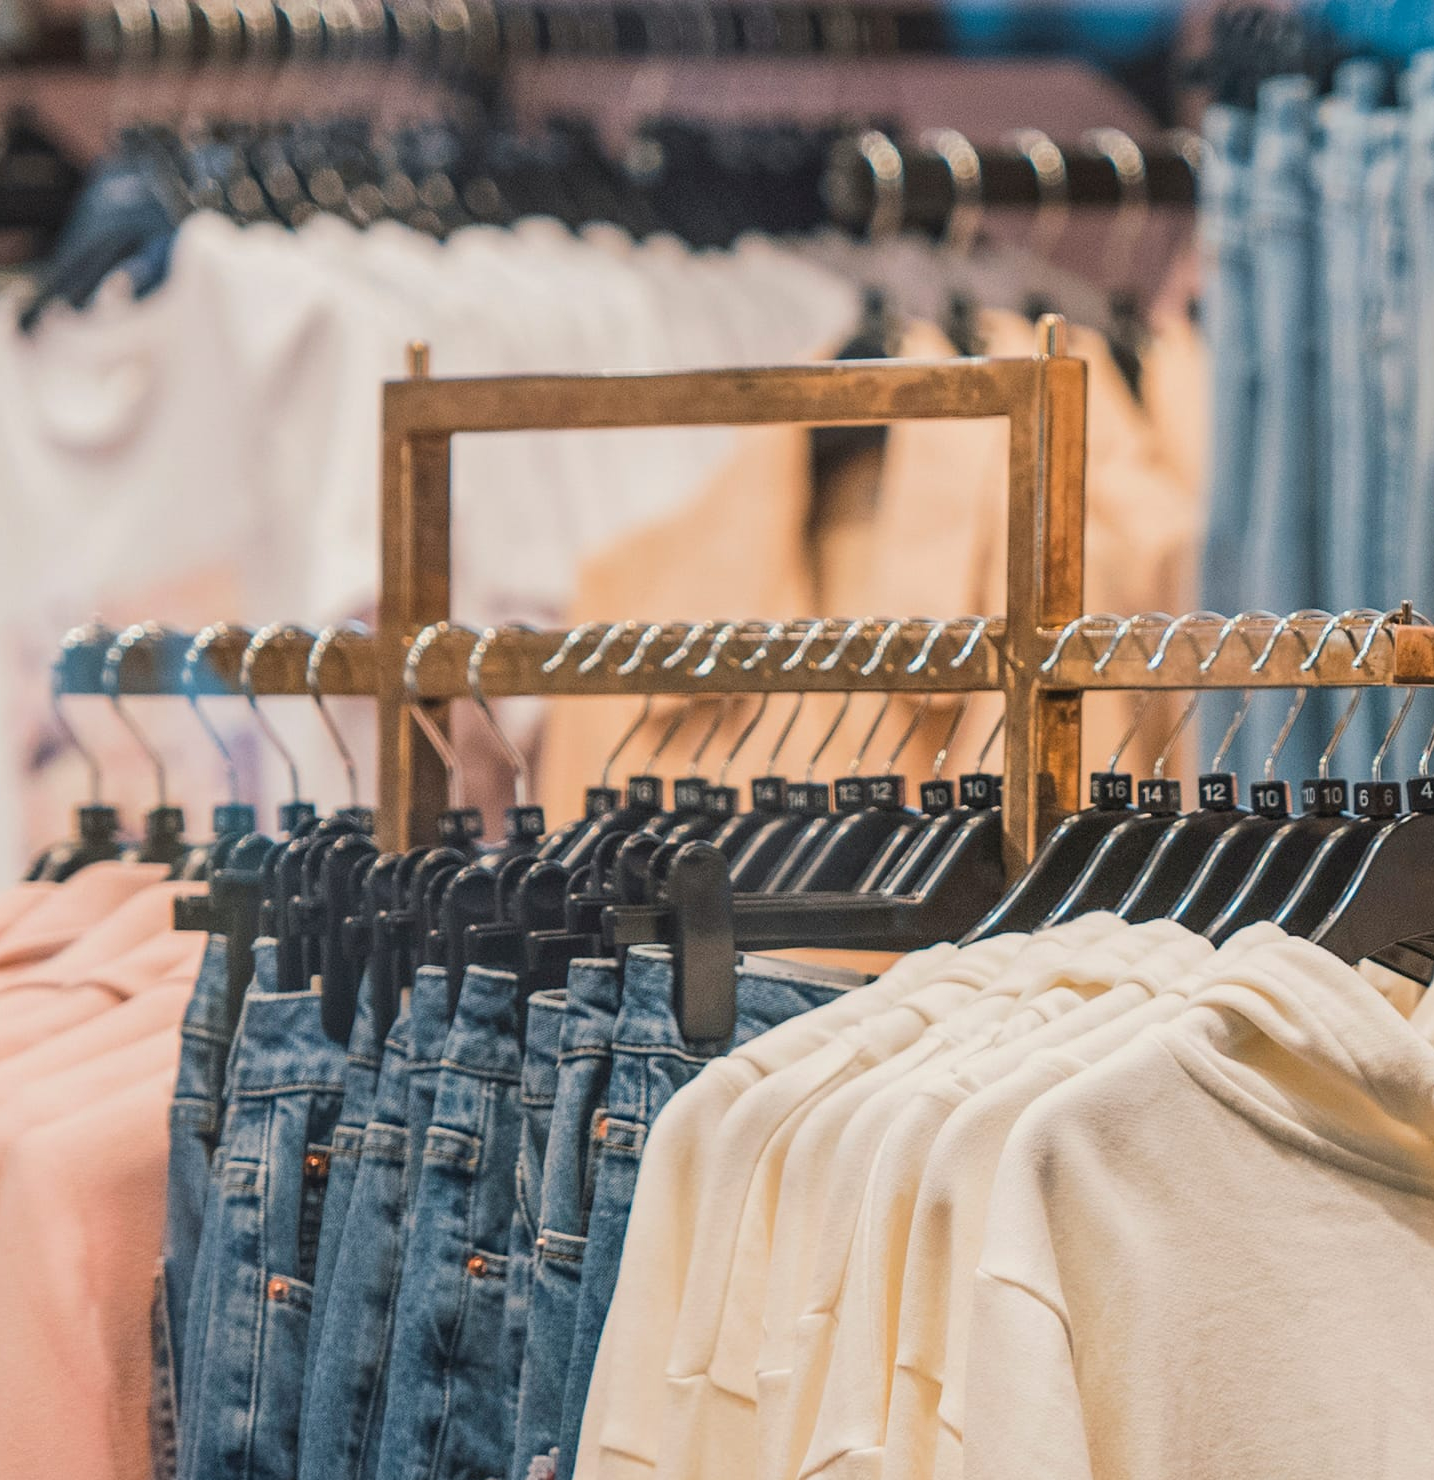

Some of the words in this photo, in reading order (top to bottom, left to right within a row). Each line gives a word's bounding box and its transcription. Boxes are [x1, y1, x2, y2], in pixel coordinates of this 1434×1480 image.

[870, 781, 893, 800] 12
[924, 788, 948, 806] 10
[964, 779, 987, 798] 10
[1106, 780, 1127, 799] 16
[1142, 785, 1163, 803] 14
[1202, 783, 1227, 801] 12
[1302, 788, 1316, 805] 10
[1322, 786, 1343, 804] 10
[1384, 788, 1394, 806] 6
[1420, 781, 1434, 799] 4
[1256, 789, 1279, 808] 10
[1359, 789, 1369, 807] 6
